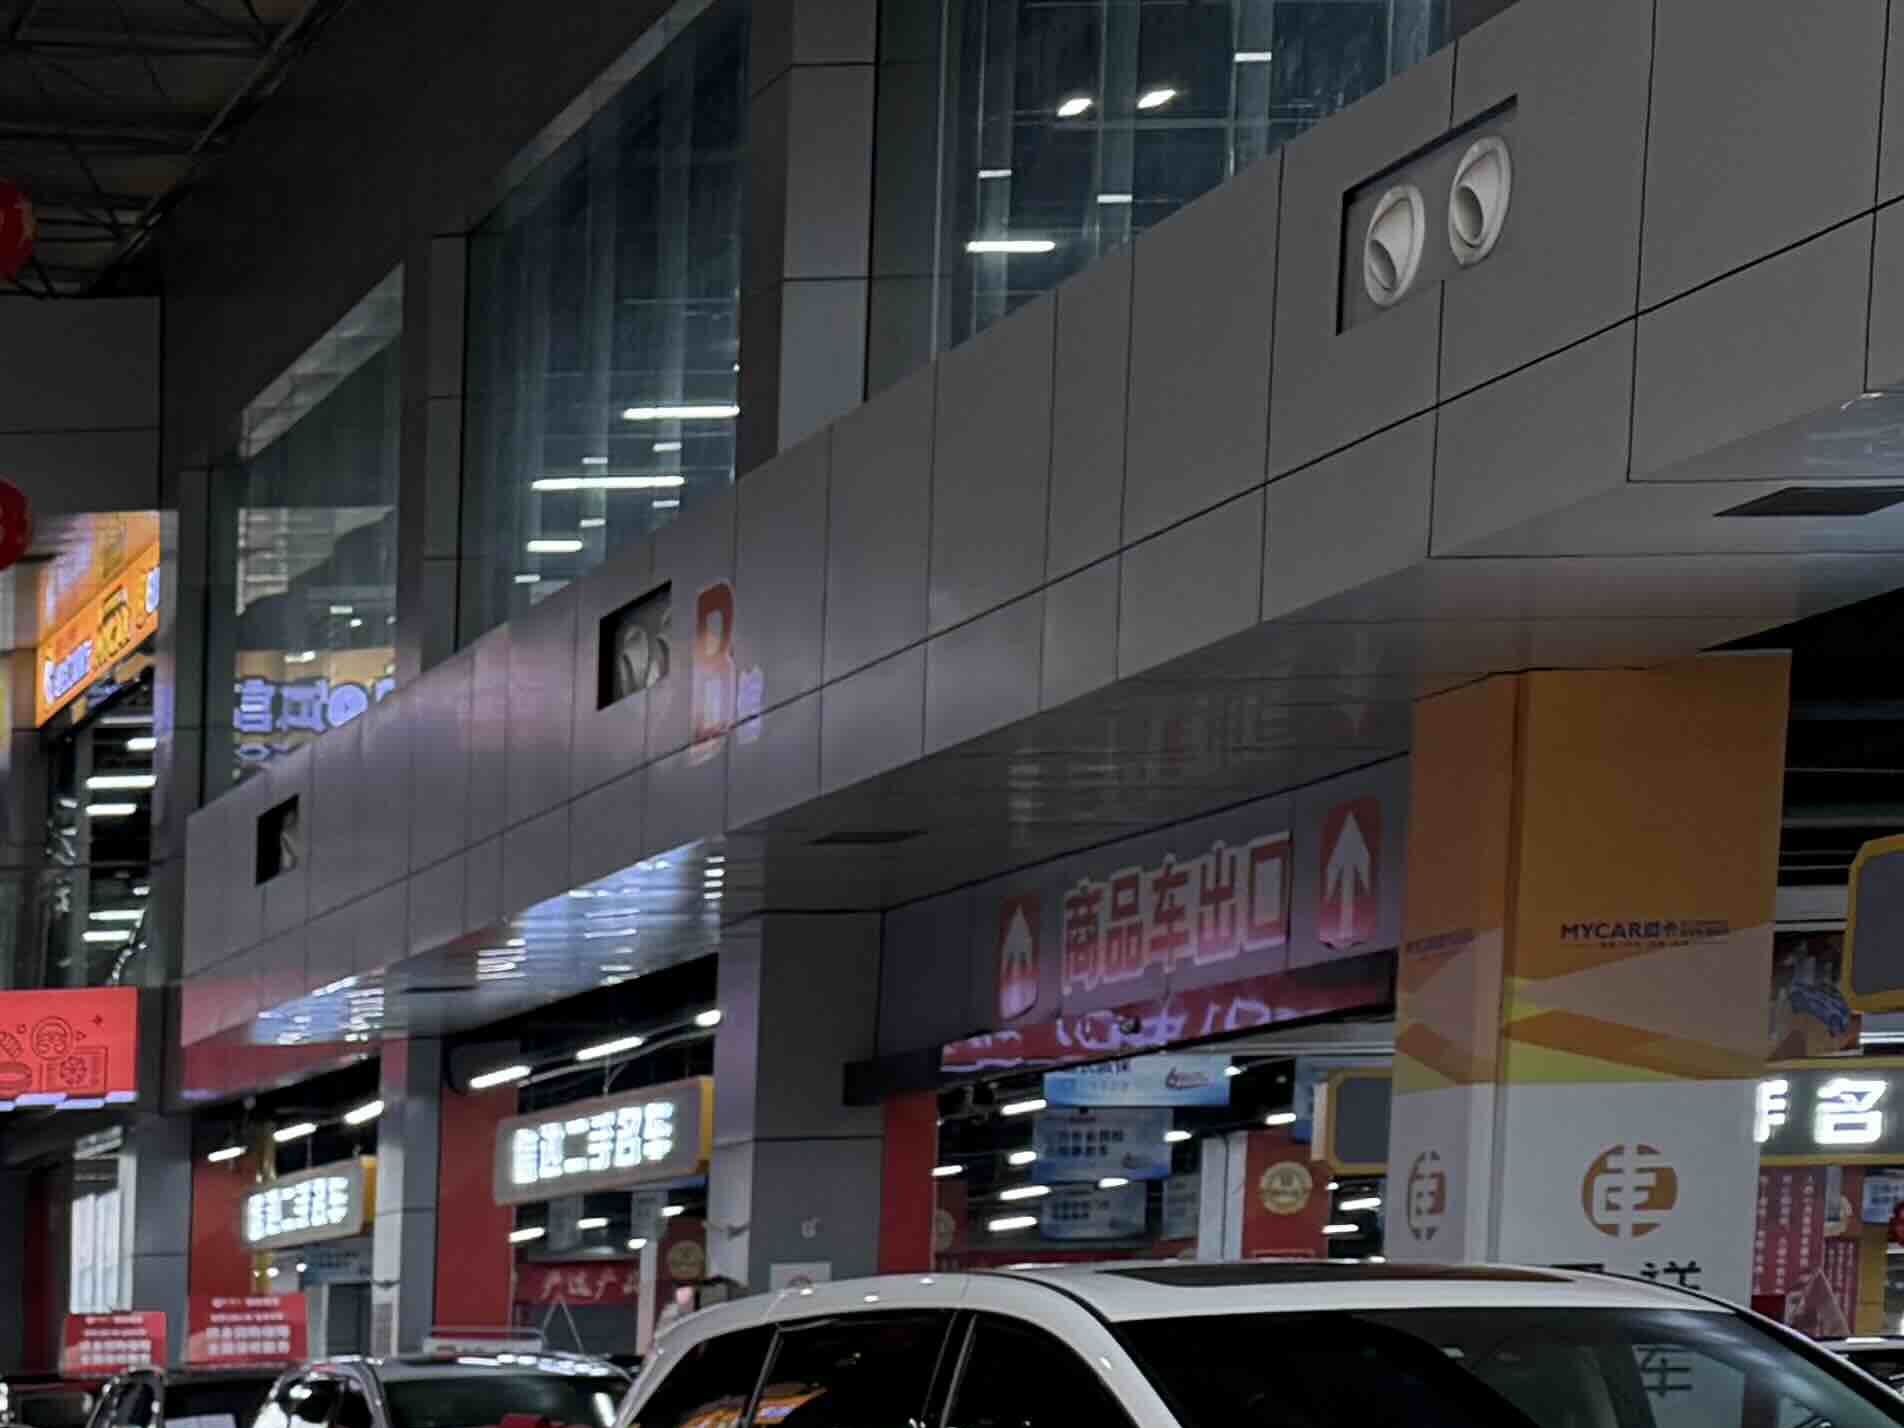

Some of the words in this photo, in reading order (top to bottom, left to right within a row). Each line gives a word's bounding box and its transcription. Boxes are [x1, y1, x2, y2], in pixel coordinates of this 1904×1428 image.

[1060, 832, 1292, 996] 商品车出口
